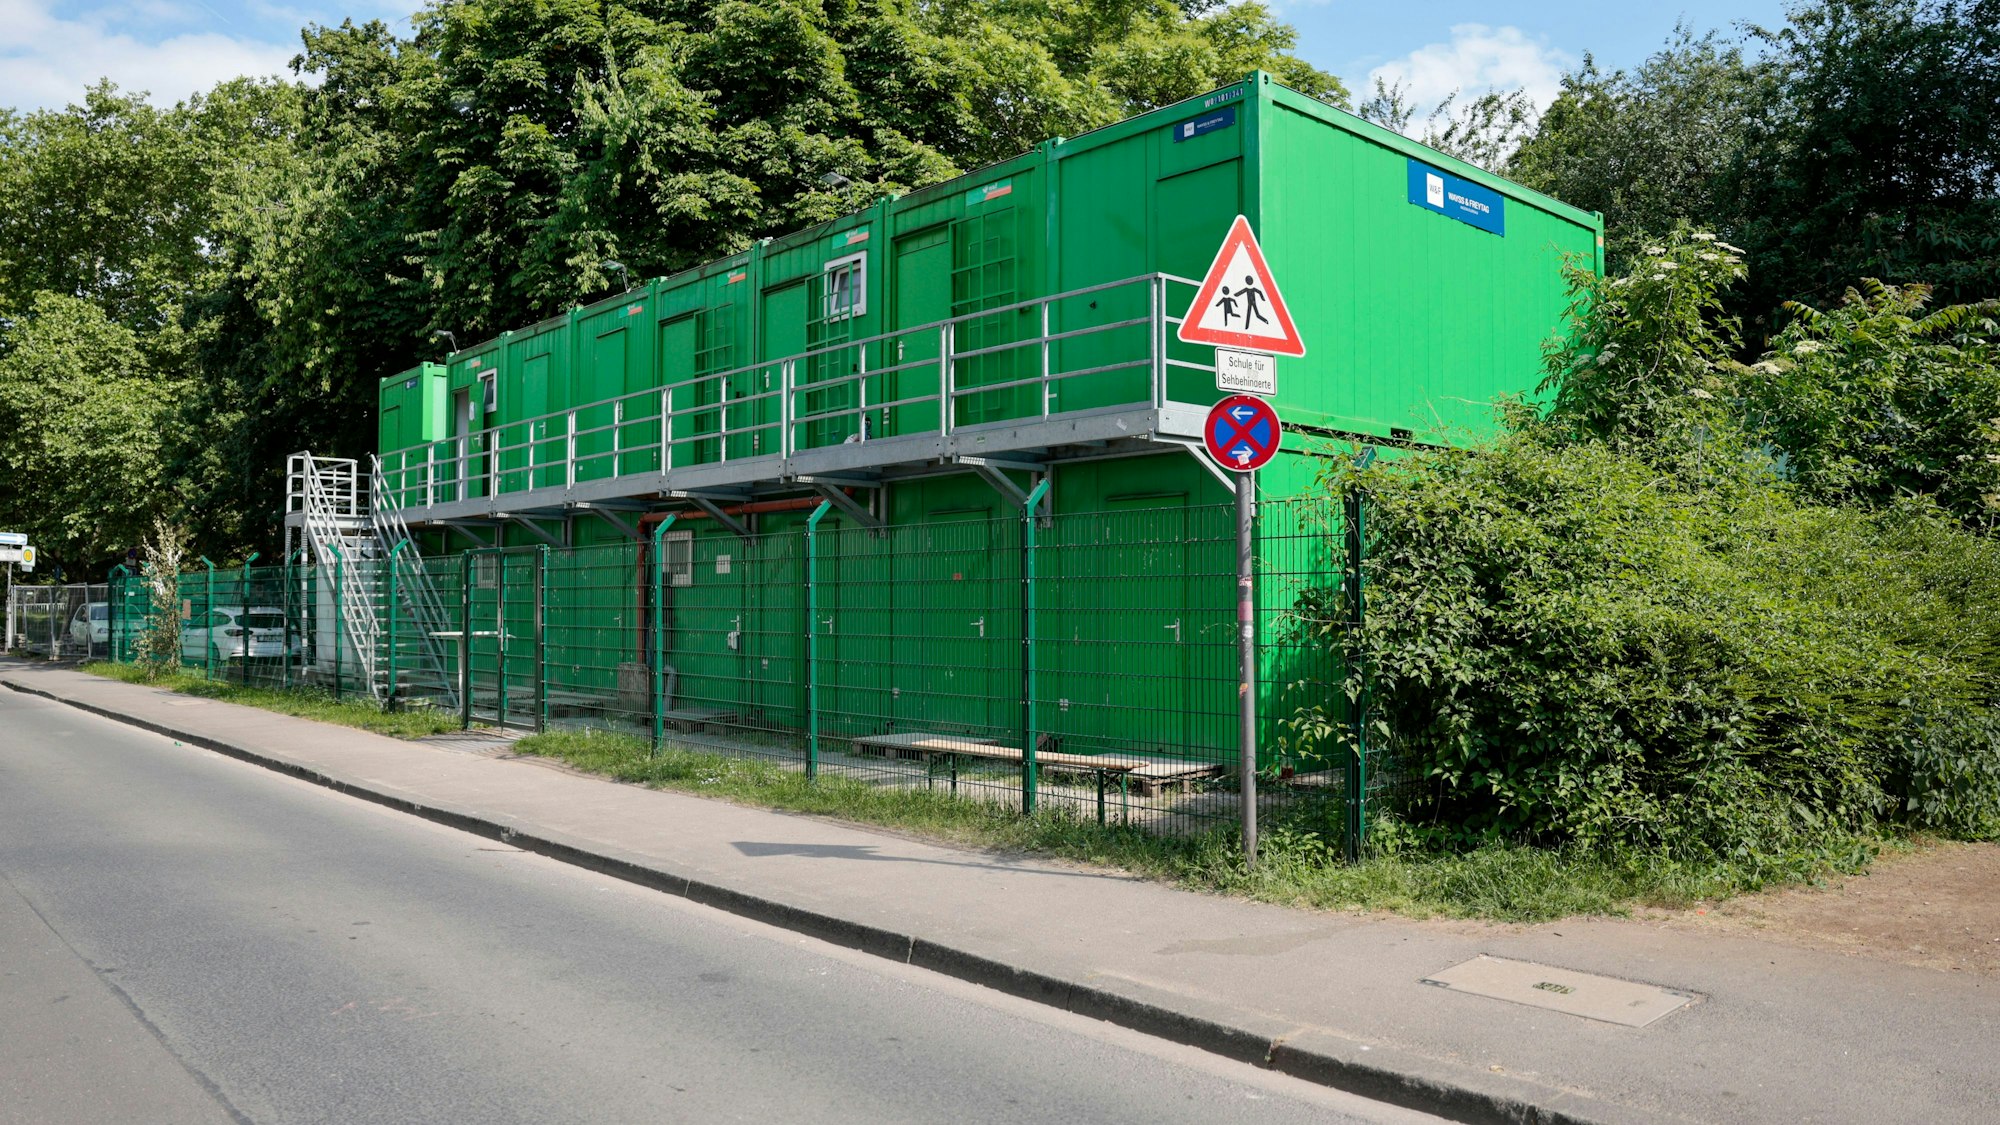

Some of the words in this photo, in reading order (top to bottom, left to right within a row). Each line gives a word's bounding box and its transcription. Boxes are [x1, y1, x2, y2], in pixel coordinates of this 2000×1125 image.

[1429, 184, 1442, 194] W&F
[1465, 197, 1470, 206] &
[1470, 199, 1490, 214] FREYTAG
[1228, 356, 1252, 370] Schule
[1254, 360, 1264, 370] für
